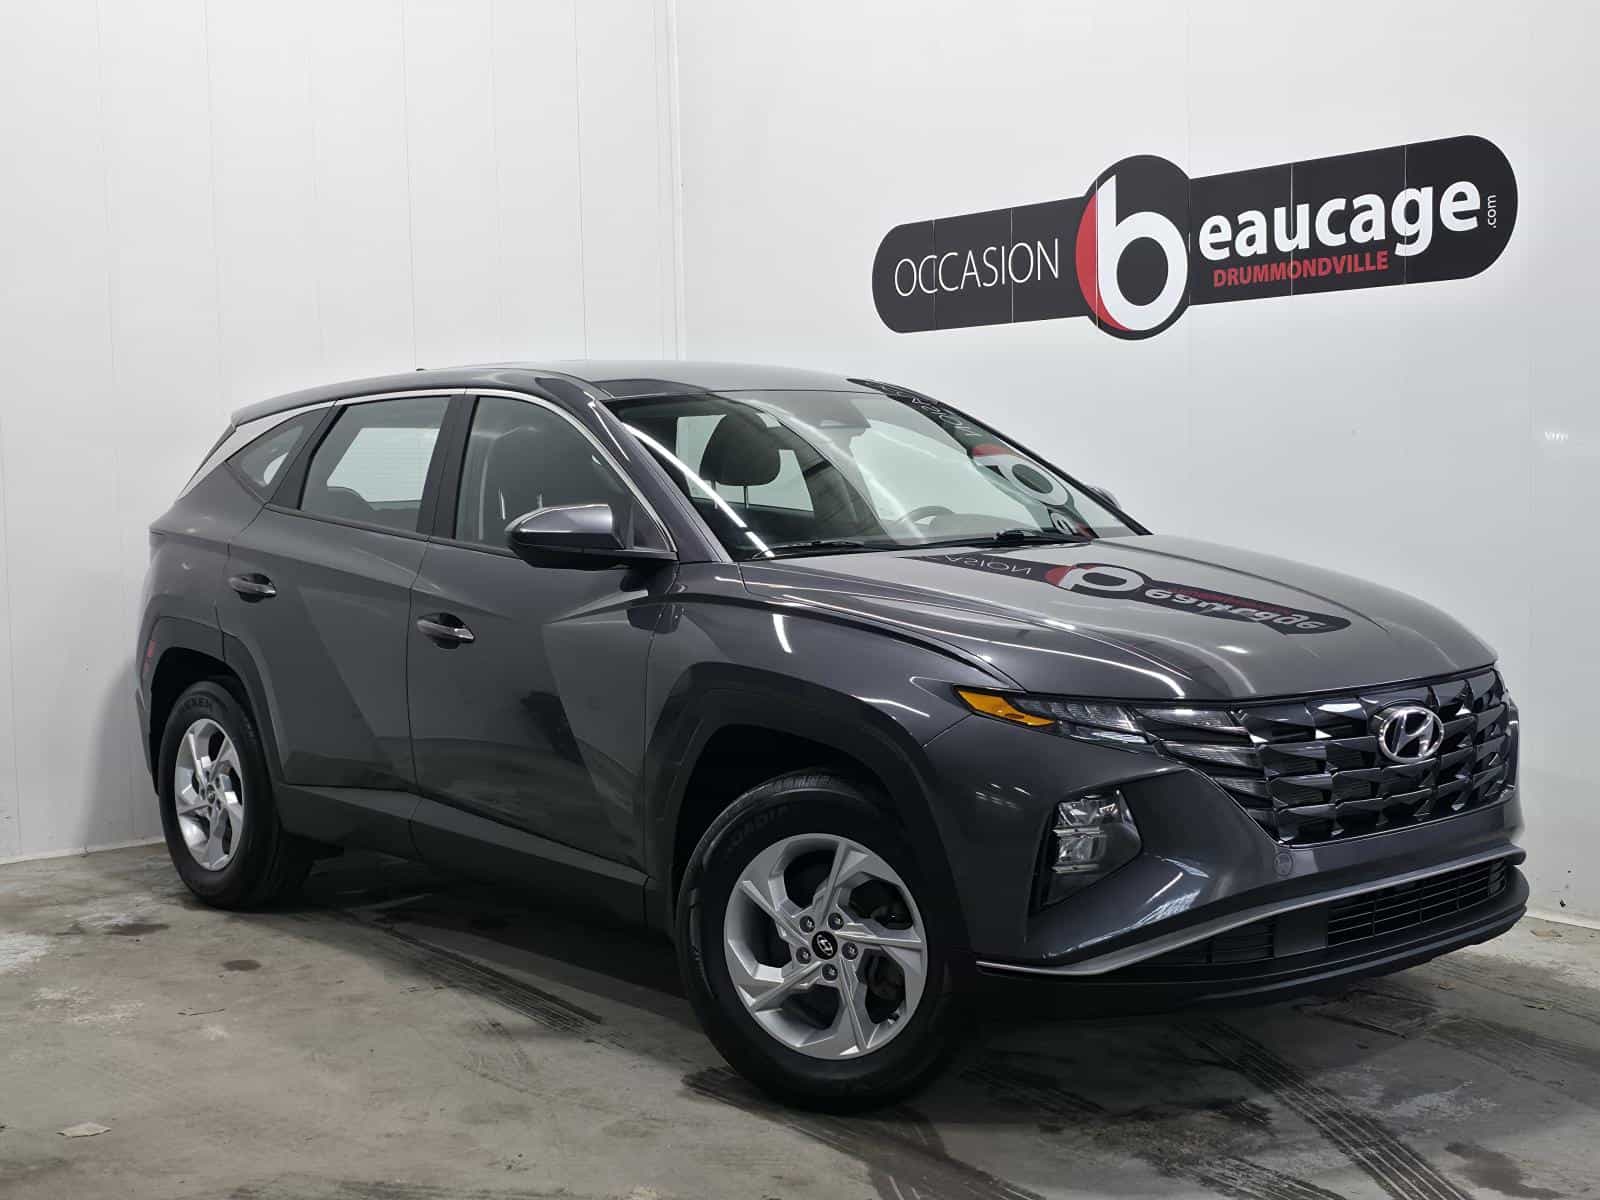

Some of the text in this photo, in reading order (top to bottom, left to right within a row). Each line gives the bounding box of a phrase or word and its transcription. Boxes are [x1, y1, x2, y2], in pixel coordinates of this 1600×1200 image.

[1487, 194, 1498, 229] .com
[893, 239, 1060, 297] OCCASION
[1213, 251, 1389, 288] DRUMMONDVILLE
